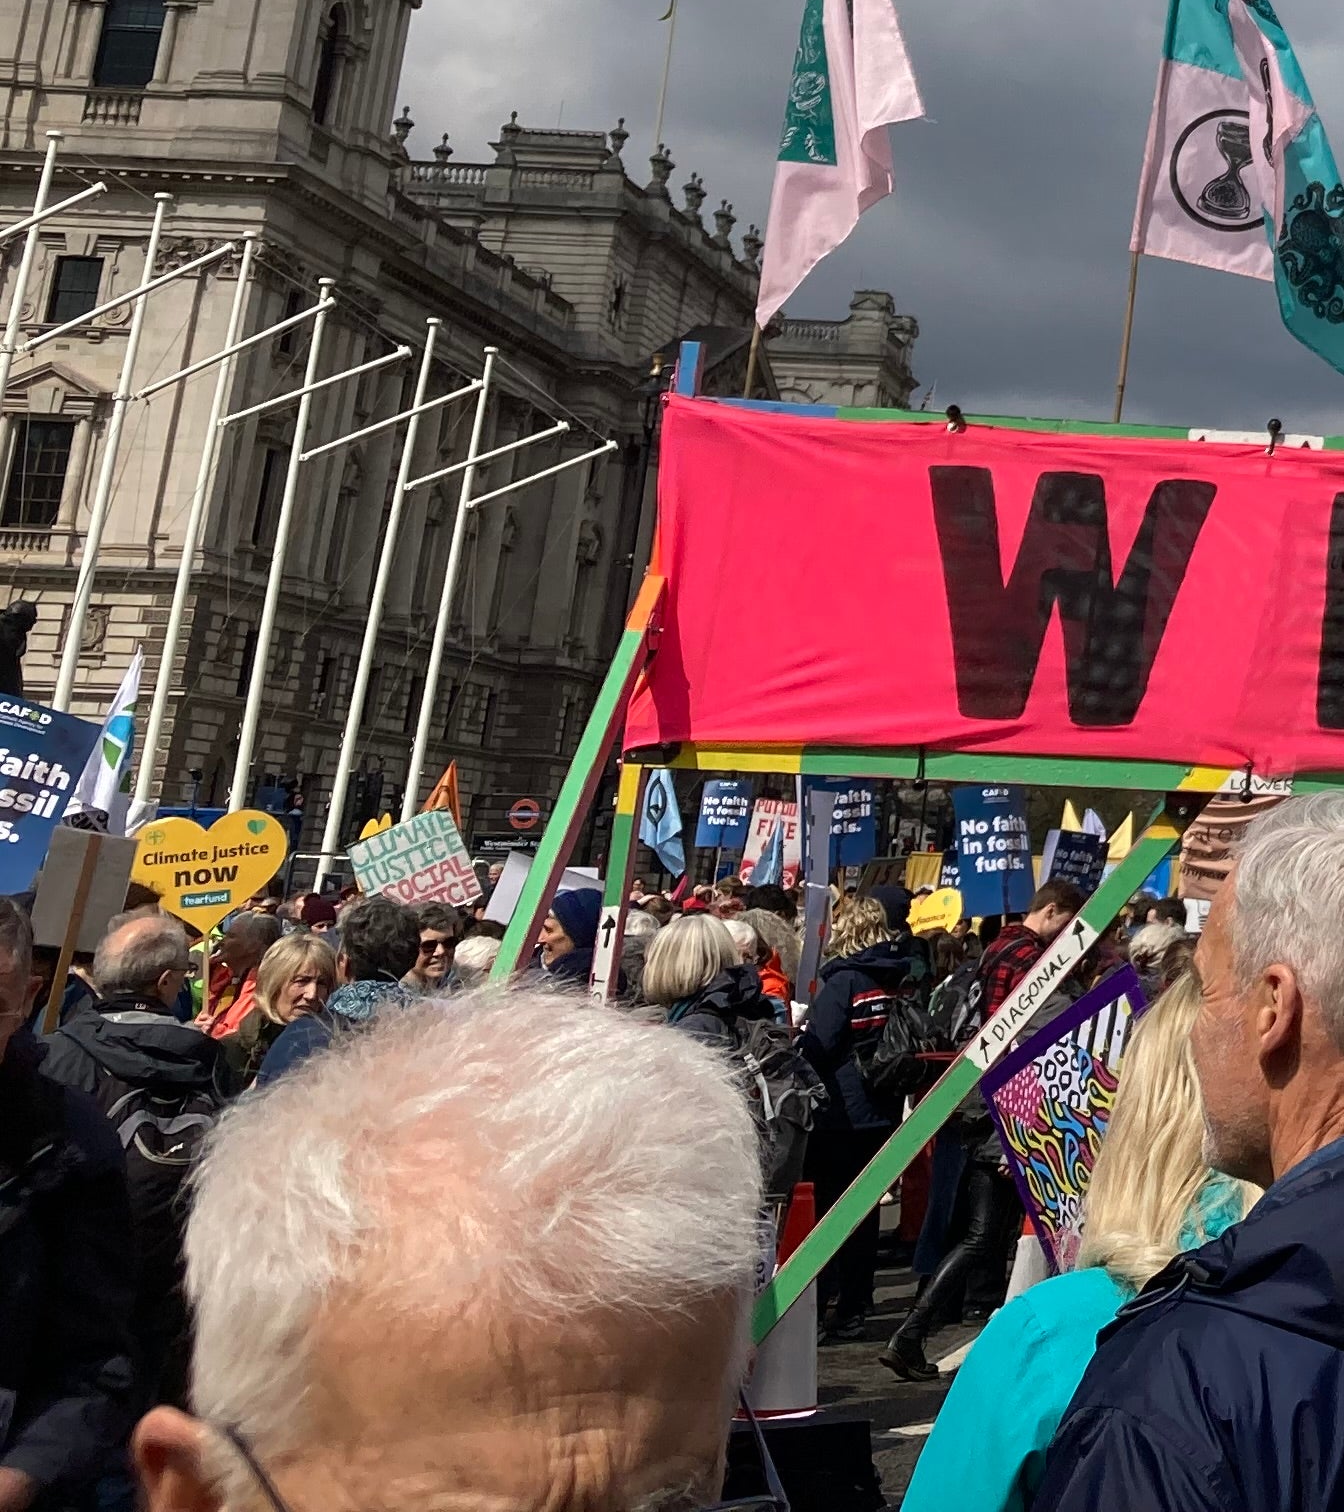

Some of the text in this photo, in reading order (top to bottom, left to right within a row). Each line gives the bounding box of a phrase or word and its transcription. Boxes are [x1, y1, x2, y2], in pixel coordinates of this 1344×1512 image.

[1230, 778, 1295, 791] LOWER
[0, 788, 60, 818] ssil
[703, 806, 747, 817] in fossil
[704, 796, 748, 807] No faith
[832, 803, 871, 820] ossil
[707, 816, 739, 826] fuels.
[756, 819, 797, 840] FIE
[960, 814, 1027, 836] No faith
[351, 810, 455, 868] CLIMATE
[962, 834, 1028, 855] in fossil
[143, 842, 269, 866] Climate justice
[357, 830, 462, 893] JUSTICE
[975, 854, 1025, 873] fuels.
[174, 864, 239, 888] now
[382, 855, 472, 901] SOCIAL
[940, 874, 953, 886] in
[942, 865, 959, 875] No
[183, 892, 228, 906] tearfund
[991, 954, 1071, 1042] DIAGONAL
